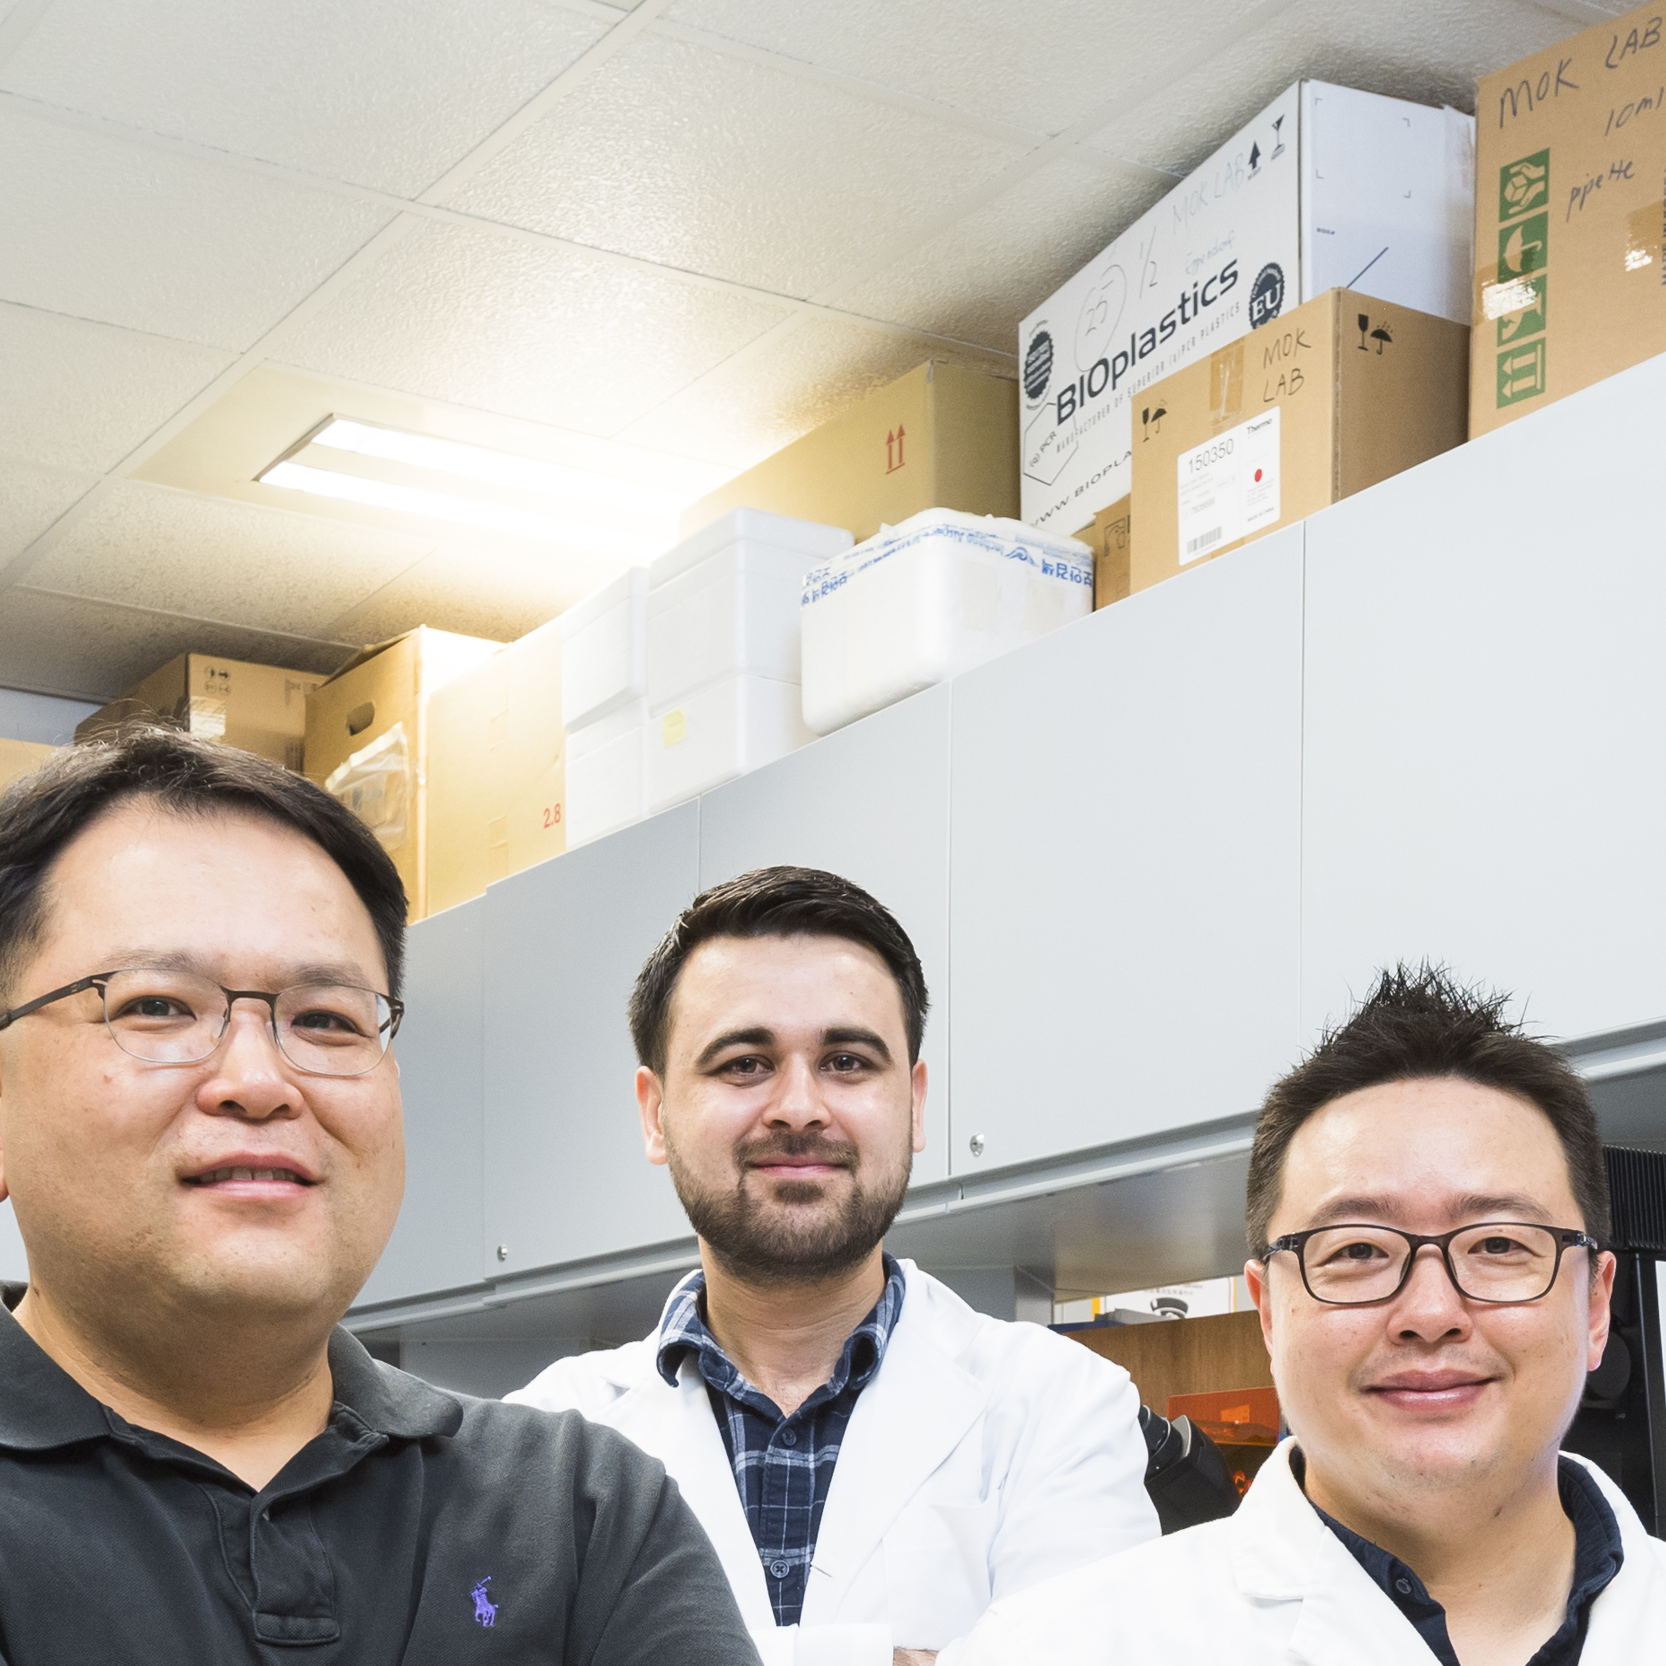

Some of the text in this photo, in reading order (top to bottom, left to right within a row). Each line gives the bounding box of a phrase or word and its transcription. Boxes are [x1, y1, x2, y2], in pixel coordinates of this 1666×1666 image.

[1498, 16, 1663, 129] MOK LAB
[1251, 281, 1282, 322] EU
[1056, 258, 1238, 427] BIOplastics
[1263, 327, 1312, 369] MOK
[1262, 367, 1305, 403] LAB
[1247, 418, 1273, 435] Thermo
[1188, 438, 1234, 474] 150350
[542, 802, 562, 830] 2.8
